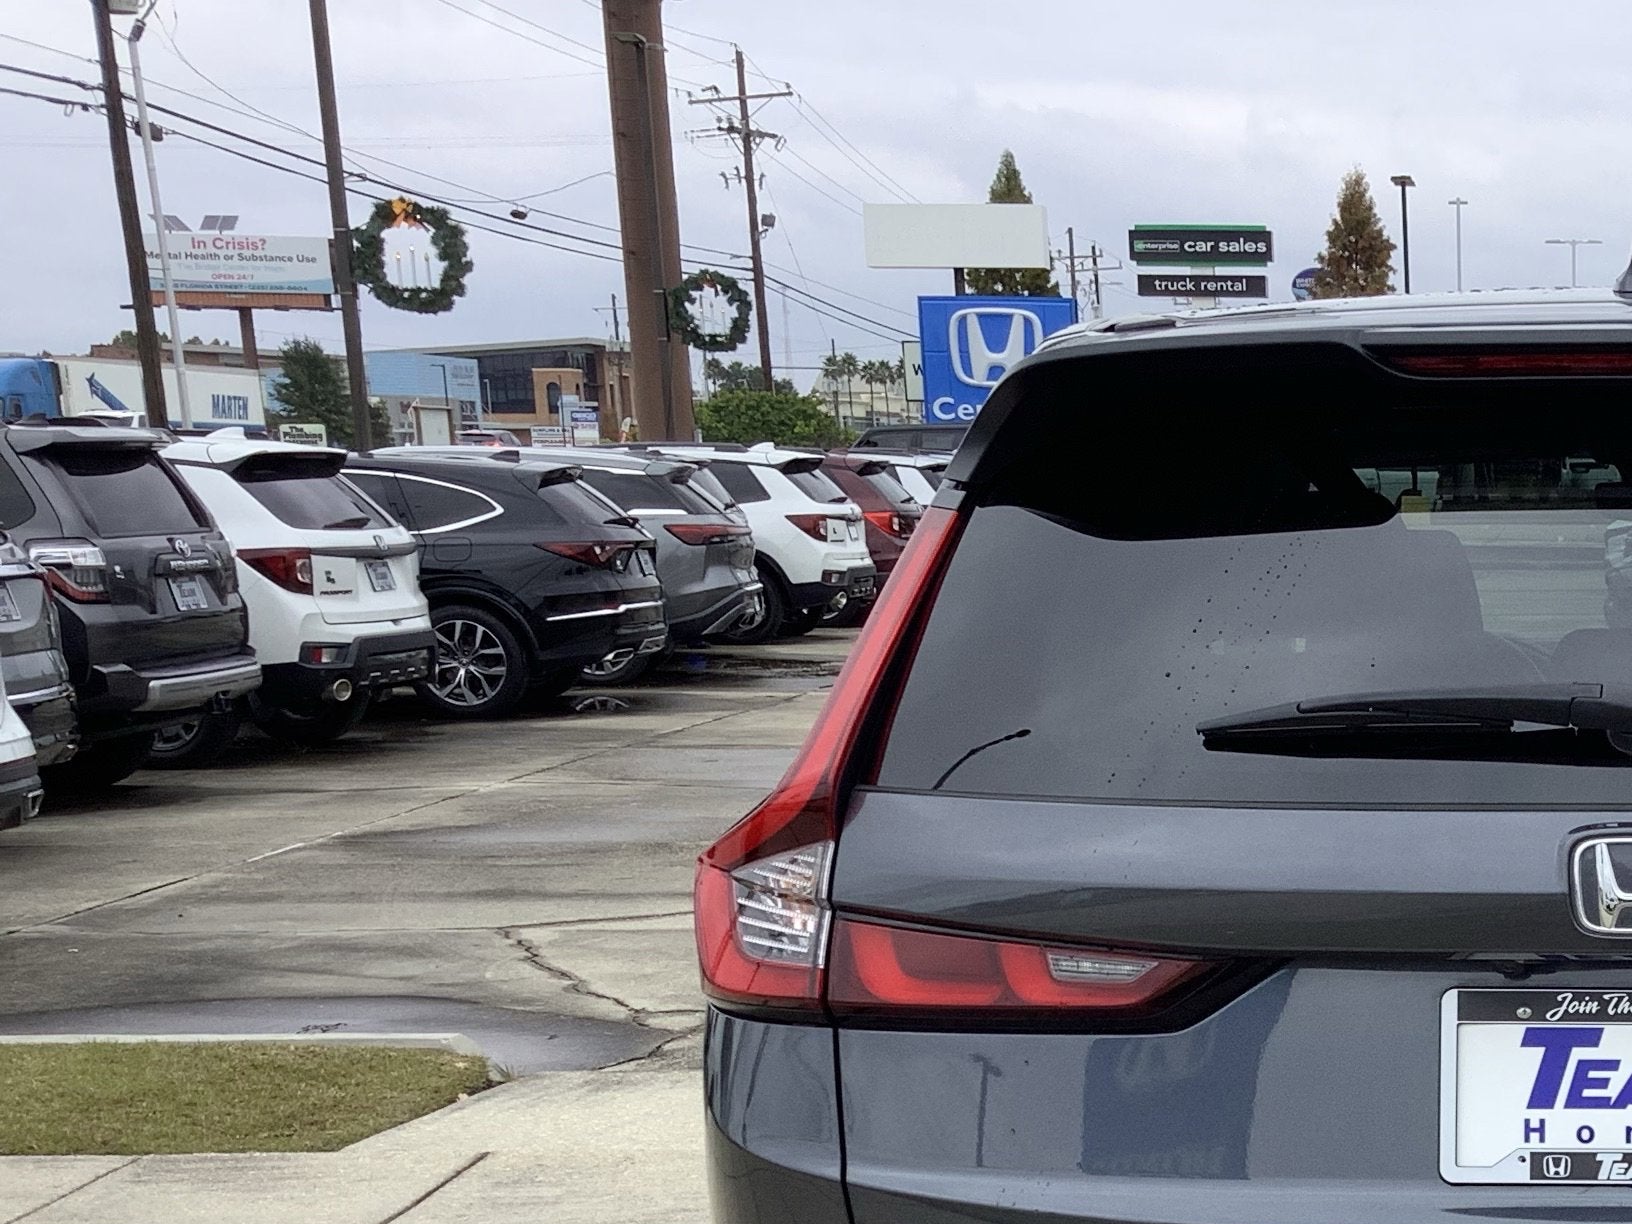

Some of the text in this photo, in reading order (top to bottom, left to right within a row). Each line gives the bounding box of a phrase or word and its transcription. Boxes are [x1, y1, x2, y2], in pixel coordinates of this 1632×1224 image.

[191, 236, 267, 251] In Crisis?
[1135, 237, 1267, 253] enterprise car sales
[146, 252, 317, 263] Metal Health or Substance Use
[211, 273, 235, 281] OPEN
[181, 282, 213, 290] FLORIDA
[216, 283, 243, 291] STREET
[1154, 278, 1247, 292] truck rental
[211, 394, 249, 420] MARTEN
[283, 432, 323, 442] Plumbing
[1545, 993, 1601, 1021] Join
